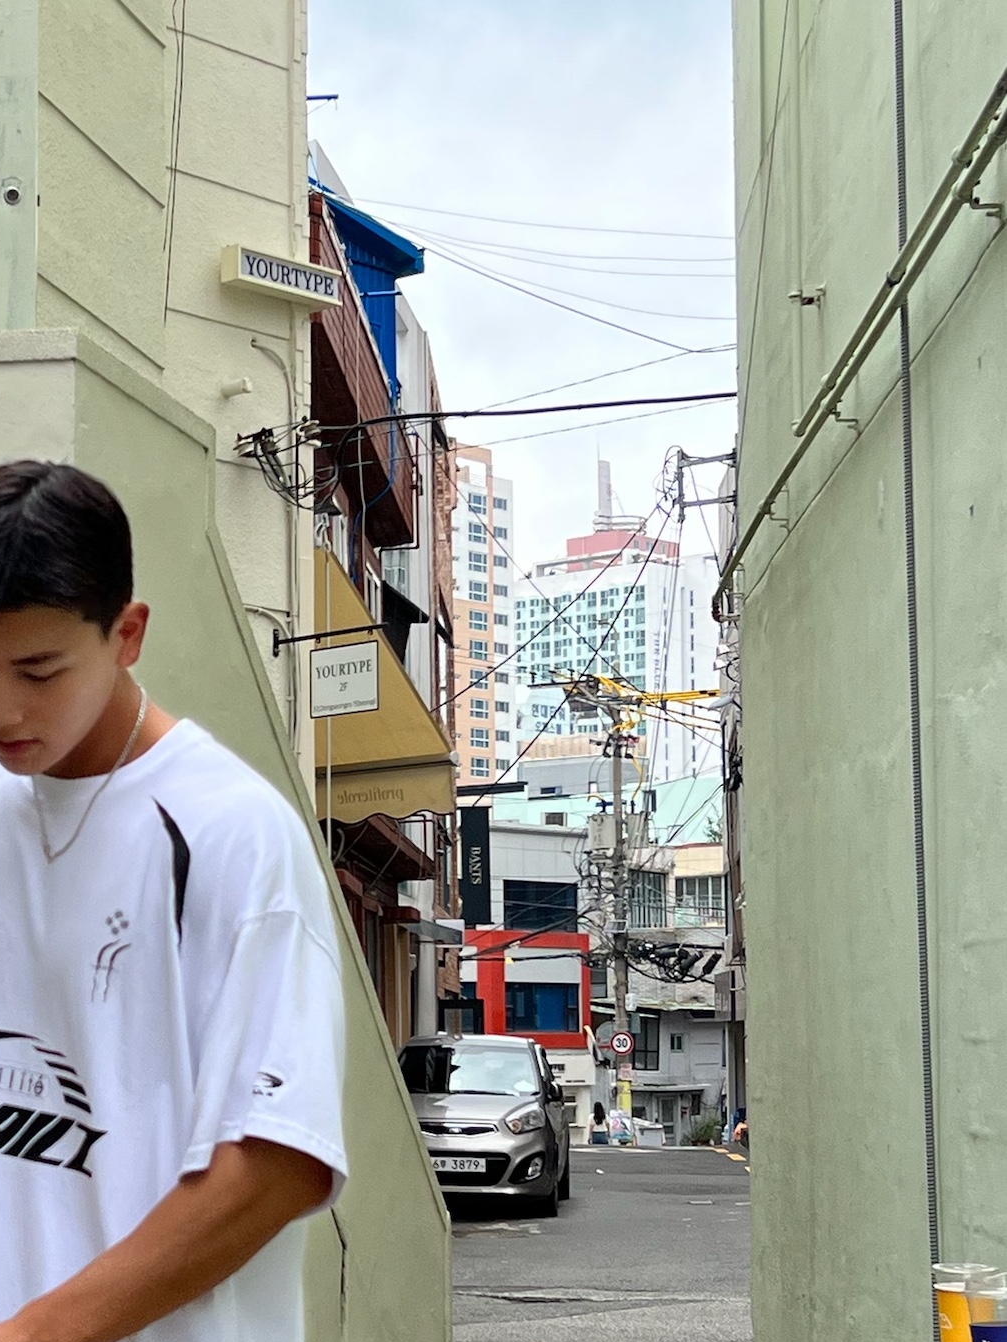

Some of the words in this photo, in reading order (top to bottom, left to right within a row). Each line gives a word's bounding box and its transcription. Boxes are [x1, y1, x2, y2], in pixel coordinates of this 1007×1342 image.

[245, 255, 334, 296] YOURTYPE
[315, 659, 373, 680] YOURTYPE
[615, 1037, 628, 1048] 30
[451, 1159, 480, 1170] 3879
